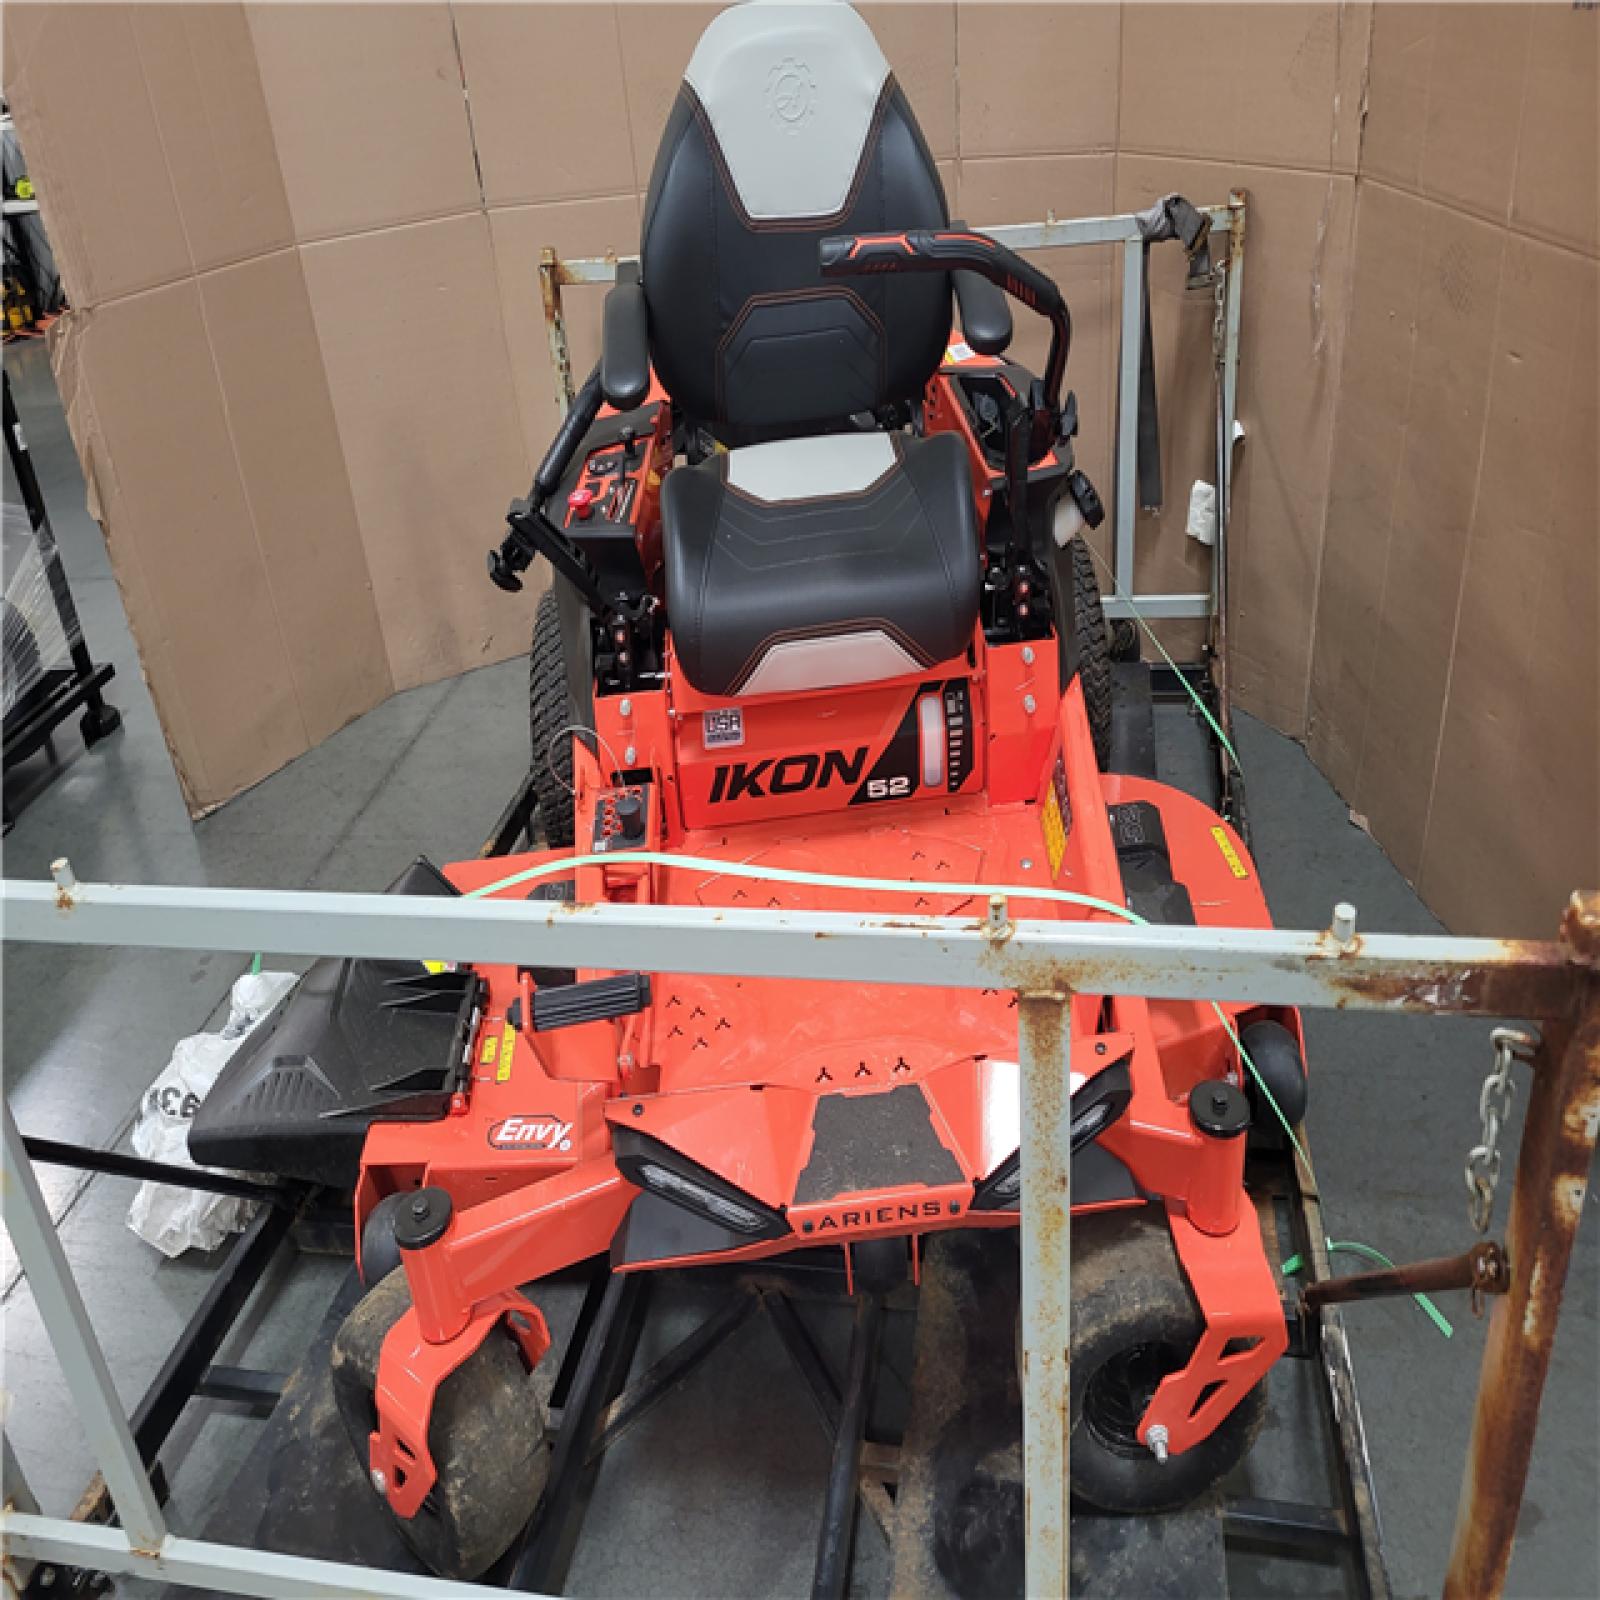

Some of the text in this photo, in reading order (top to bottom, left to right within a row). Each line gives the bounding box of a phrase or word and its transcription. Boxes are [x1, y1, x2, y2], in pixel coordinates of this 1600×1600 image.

[709, 747, 869, 803] IKON
[496, 1118, 574, 1150] Envy
[819, 1201, 941, 1231] ARIENS
